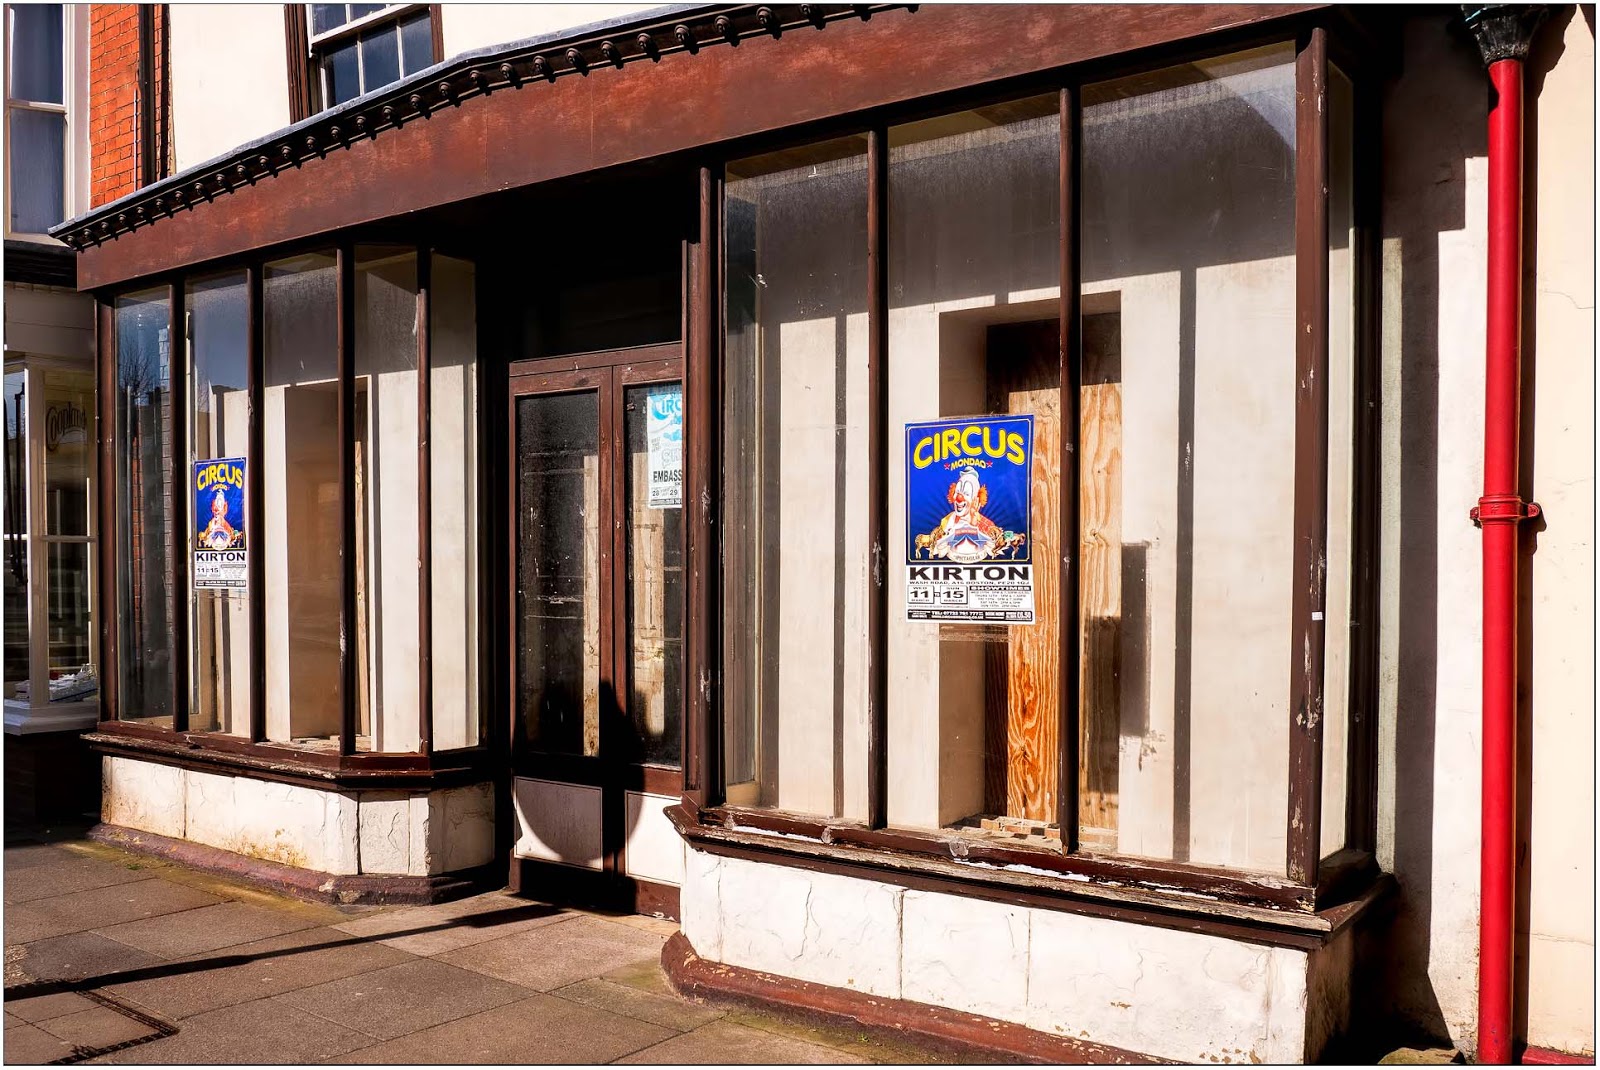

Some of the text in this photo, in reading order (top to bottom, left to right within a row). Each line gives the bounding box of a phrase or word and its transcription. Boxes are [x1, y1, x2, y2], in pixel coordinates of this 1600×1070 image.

[913, 425, 1026, 469] CIRCUS
[950, 457, 987, 471] MONDAO
[197, 463, 243, 491] CIRCUS
[196, 552, 245, 562] KIRTON
[909, 566, 1029, 581] KIRTON
[910, 590, 929, 598] 11
[942, 590, 964, 599] 15
